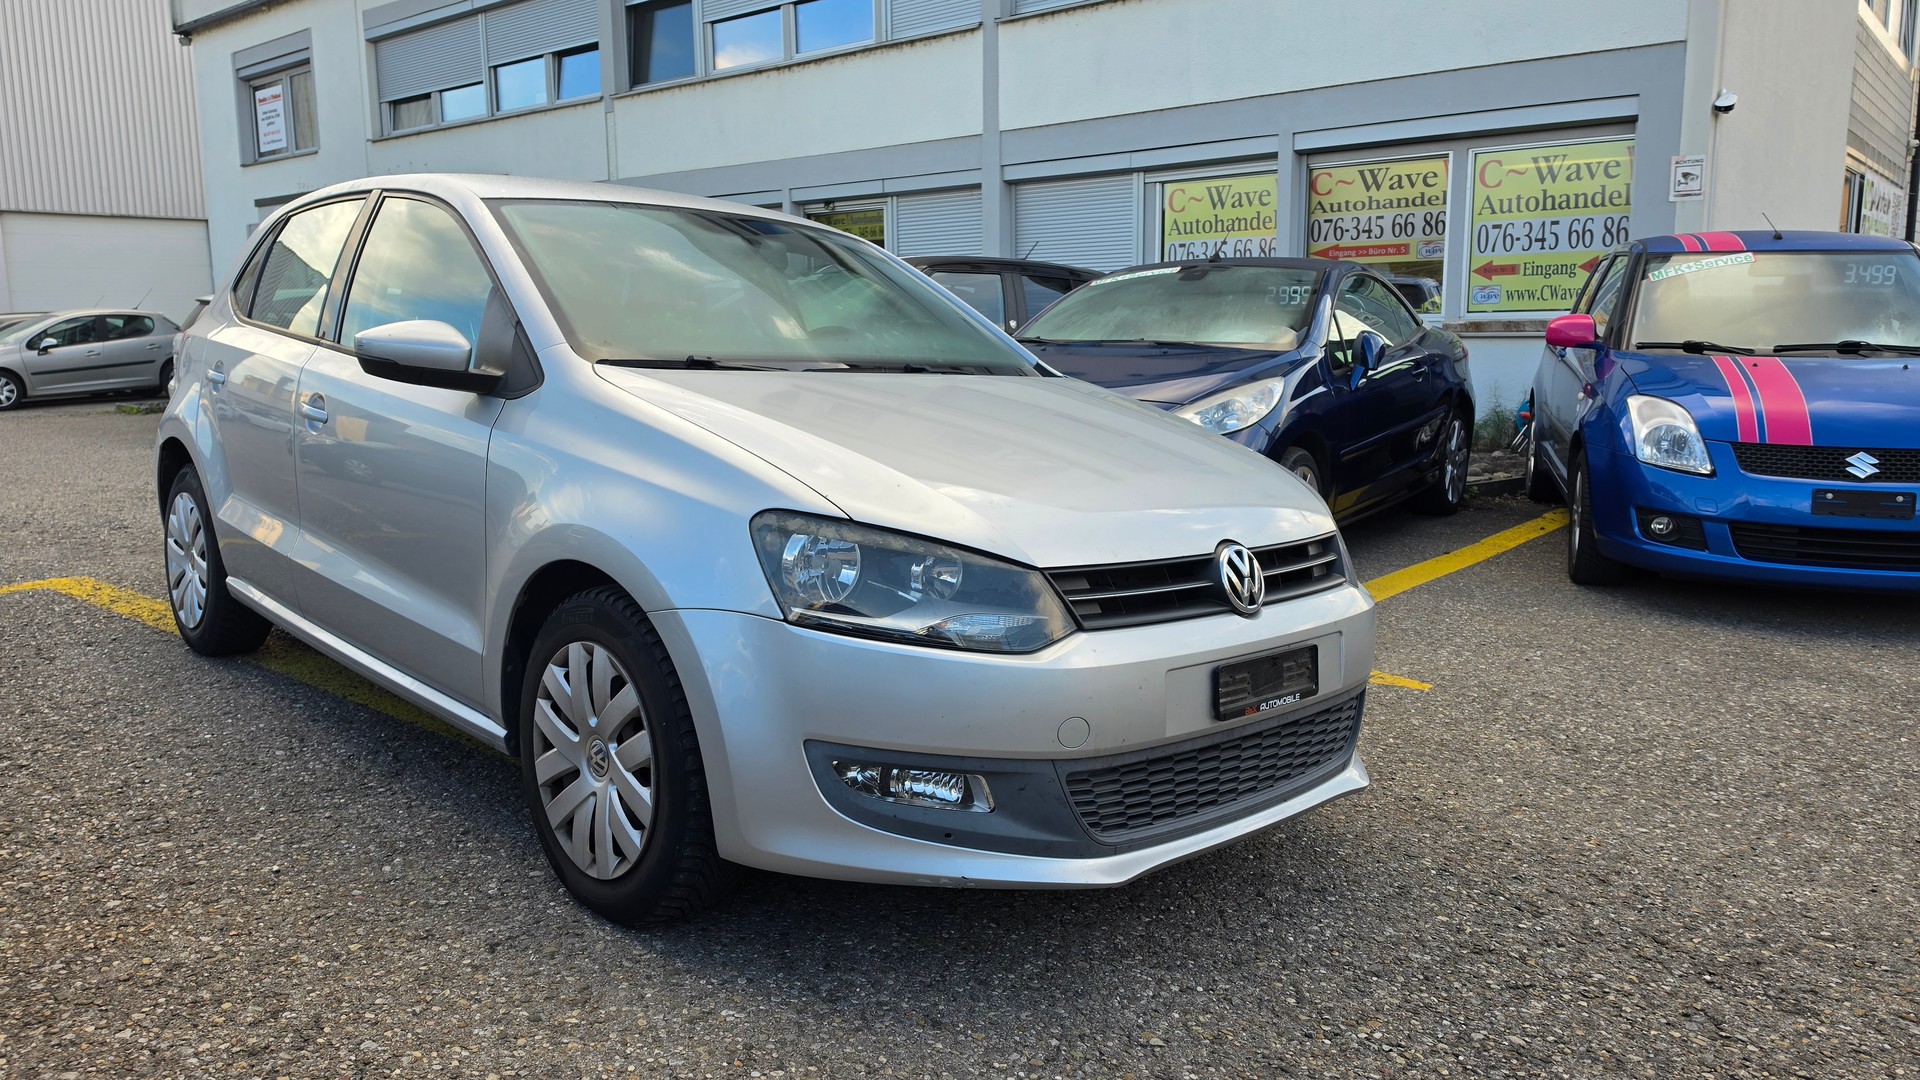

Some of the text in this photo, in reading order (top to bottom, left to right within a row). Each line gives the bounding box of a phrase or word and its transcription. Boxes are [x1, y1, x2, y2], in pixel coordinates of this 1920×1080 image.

[1310, 190, 1447, 214] Autohandel
[1477, 183, 1632, 216] Autohandel
[1311, 211, 1446, 243] 076-345 66 86
[1477, 216, 1630, 254] 076-345 66 86
[1329, 249, 1356, 257] Eingang
[1368, 247, 1386, 255] Büro
[1523, 261, 1578, 279] Eingang
[1651, 254, 1753, 280] MFK+Service
[1844, 263, 1897, 285] 3.499
[1259, 693, 1300, 711] AUTOMOBILE
